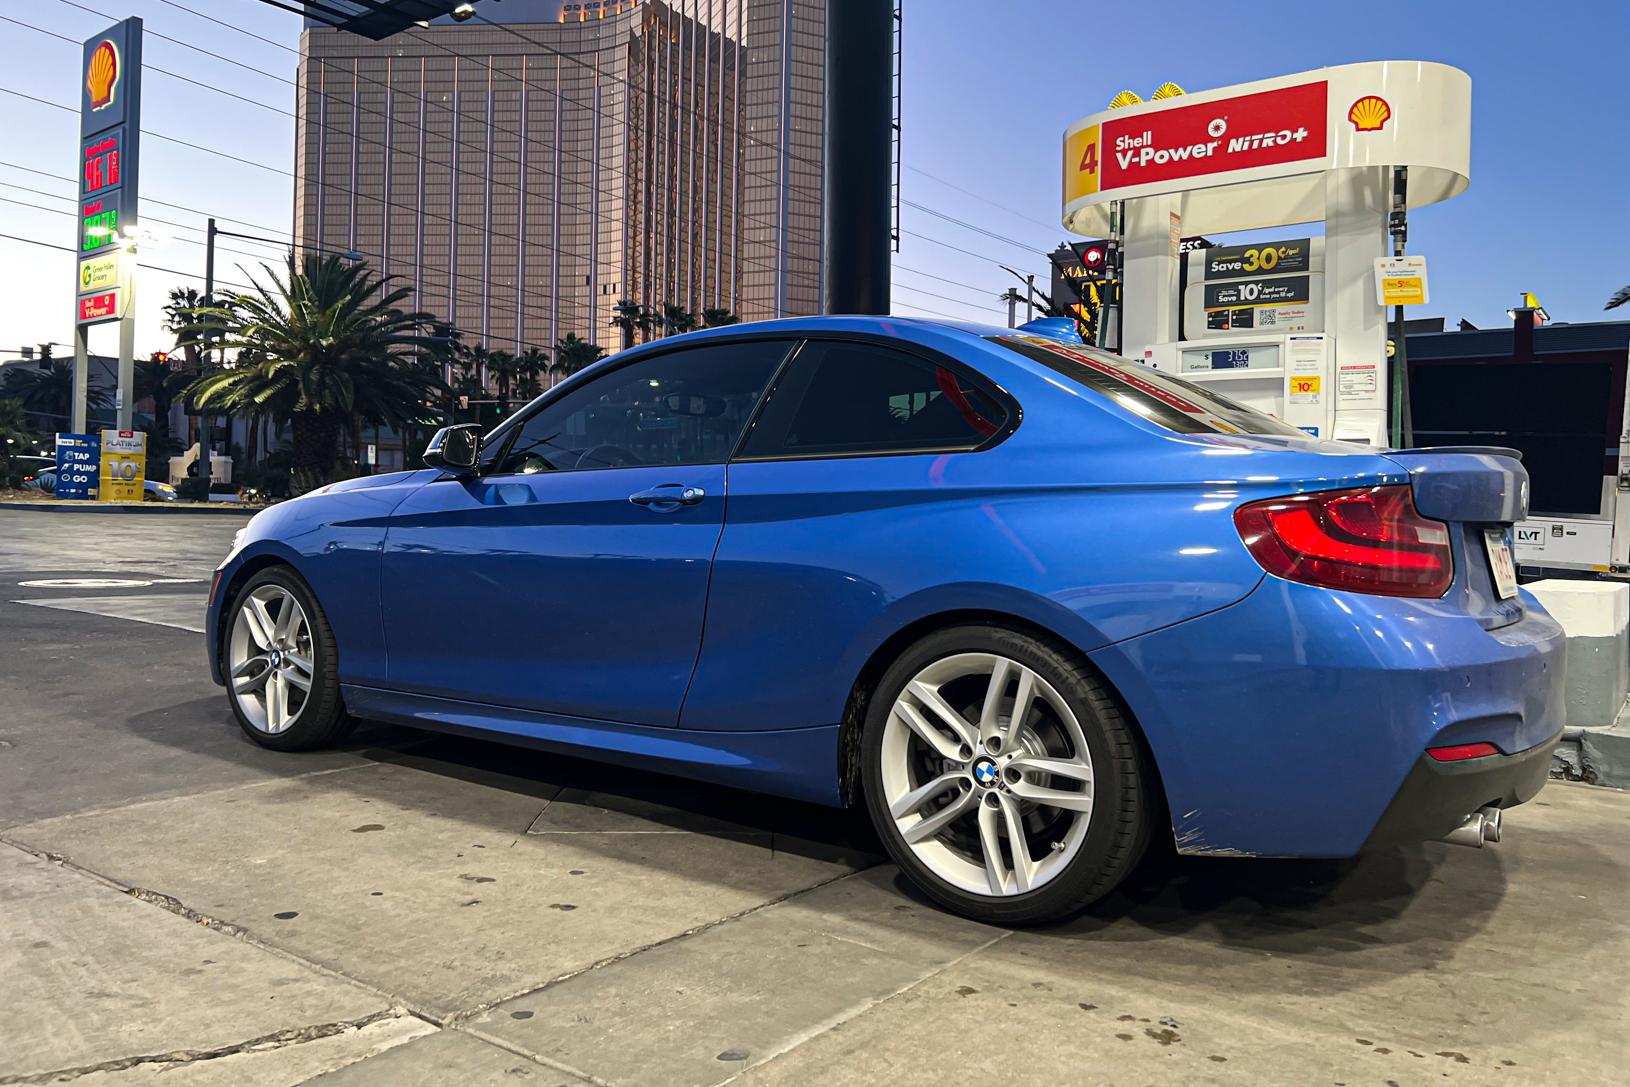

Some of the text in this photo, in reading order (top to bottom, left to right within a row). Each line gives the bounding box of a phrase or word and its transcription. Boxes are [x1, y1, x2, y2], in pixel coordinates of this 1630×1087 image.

[1116, 131, 1152, 151] Shell
[1079, 143, 1098, 175] 4
[1116, 140, 1218, 170] V-Power
[1211, 261, 1242, 272] Save
[1218, 295, 1237, 303] Save
[74, 452, 90, 460] TAP
[73, 463, 97, 472] PUMP
[72, 475, 88, 483] GO
[1518, 531, 1541, 541] LVT
